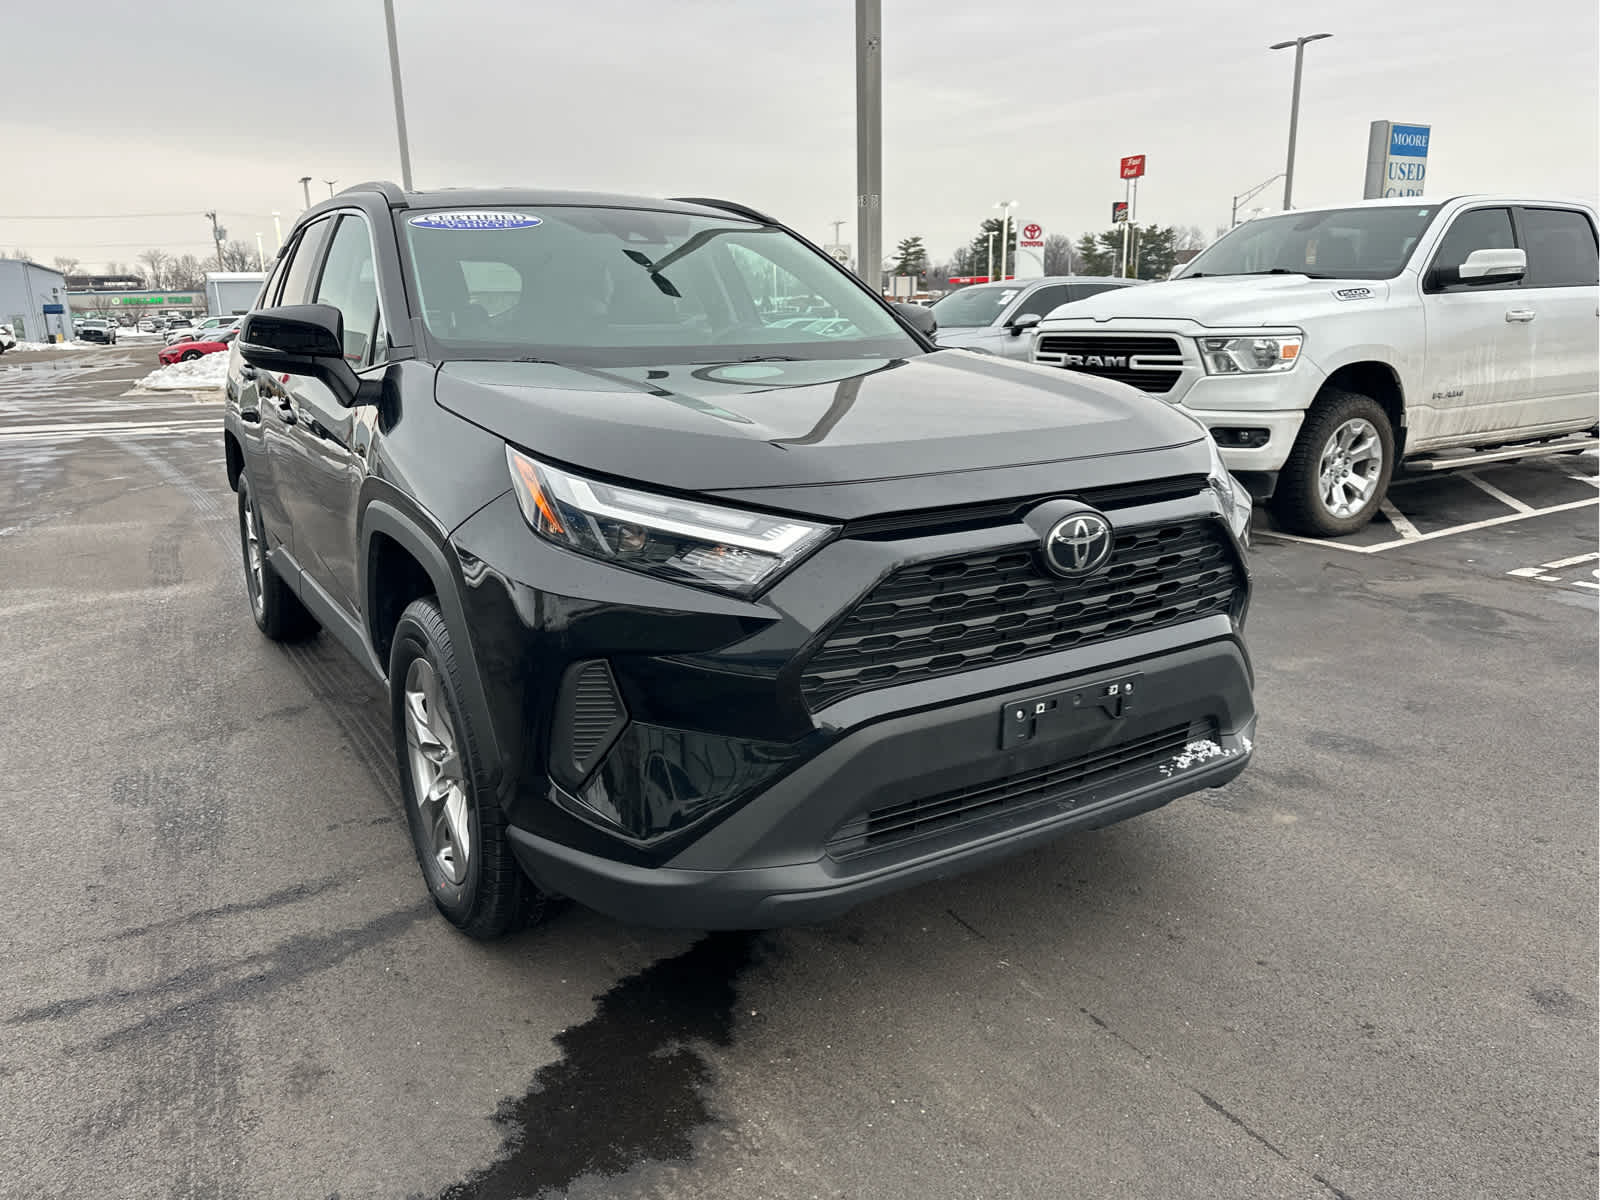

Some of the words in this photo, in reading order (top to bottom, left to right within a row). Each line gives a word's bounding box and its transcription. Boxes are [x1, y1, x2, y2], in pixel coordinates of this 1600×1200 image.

[1392, 133, 1428, 147] MOORE
[1389, 162, 1426, 181] USED
[1064, 354, 1127, 367] RAM
